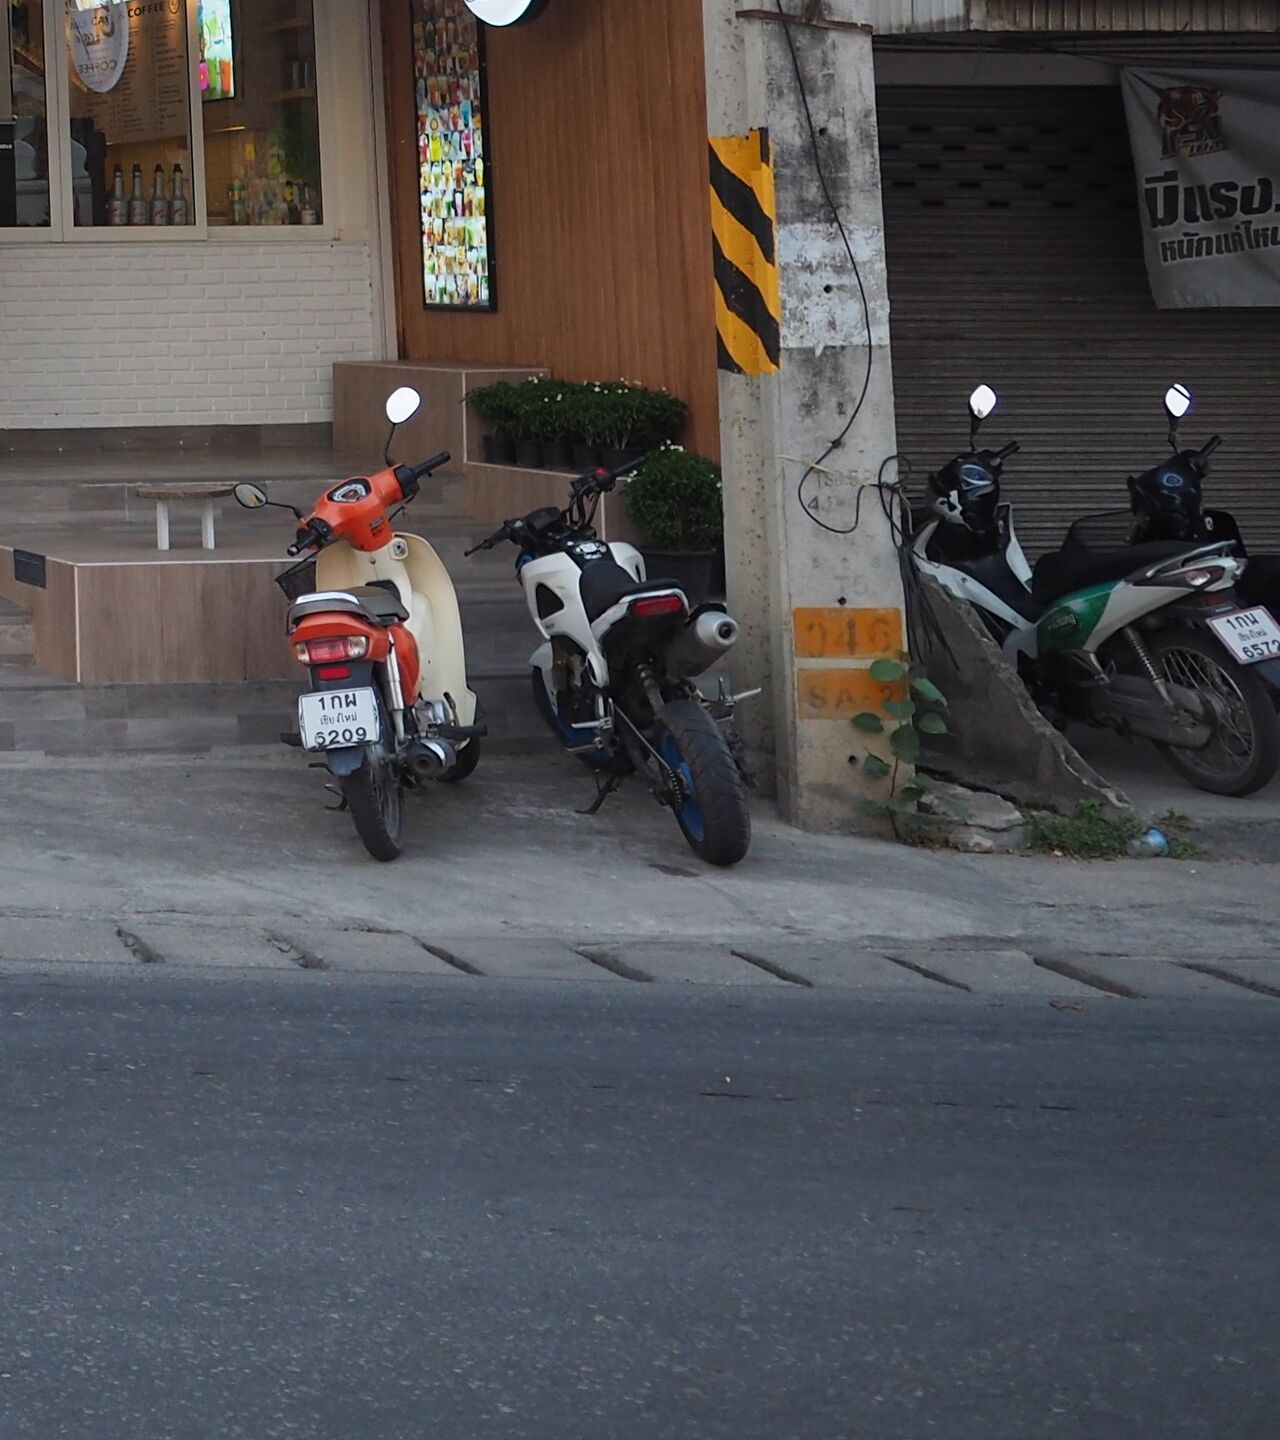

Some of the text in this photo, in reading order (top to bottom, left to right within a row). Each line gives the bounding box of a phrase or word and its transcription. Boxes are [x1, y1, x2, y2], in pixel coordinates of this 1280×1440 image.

[127, 0, 166, 18] COFFEE
[1242, 638, 1280, 659] 6572
[314, 726, 367, 747] 6209
